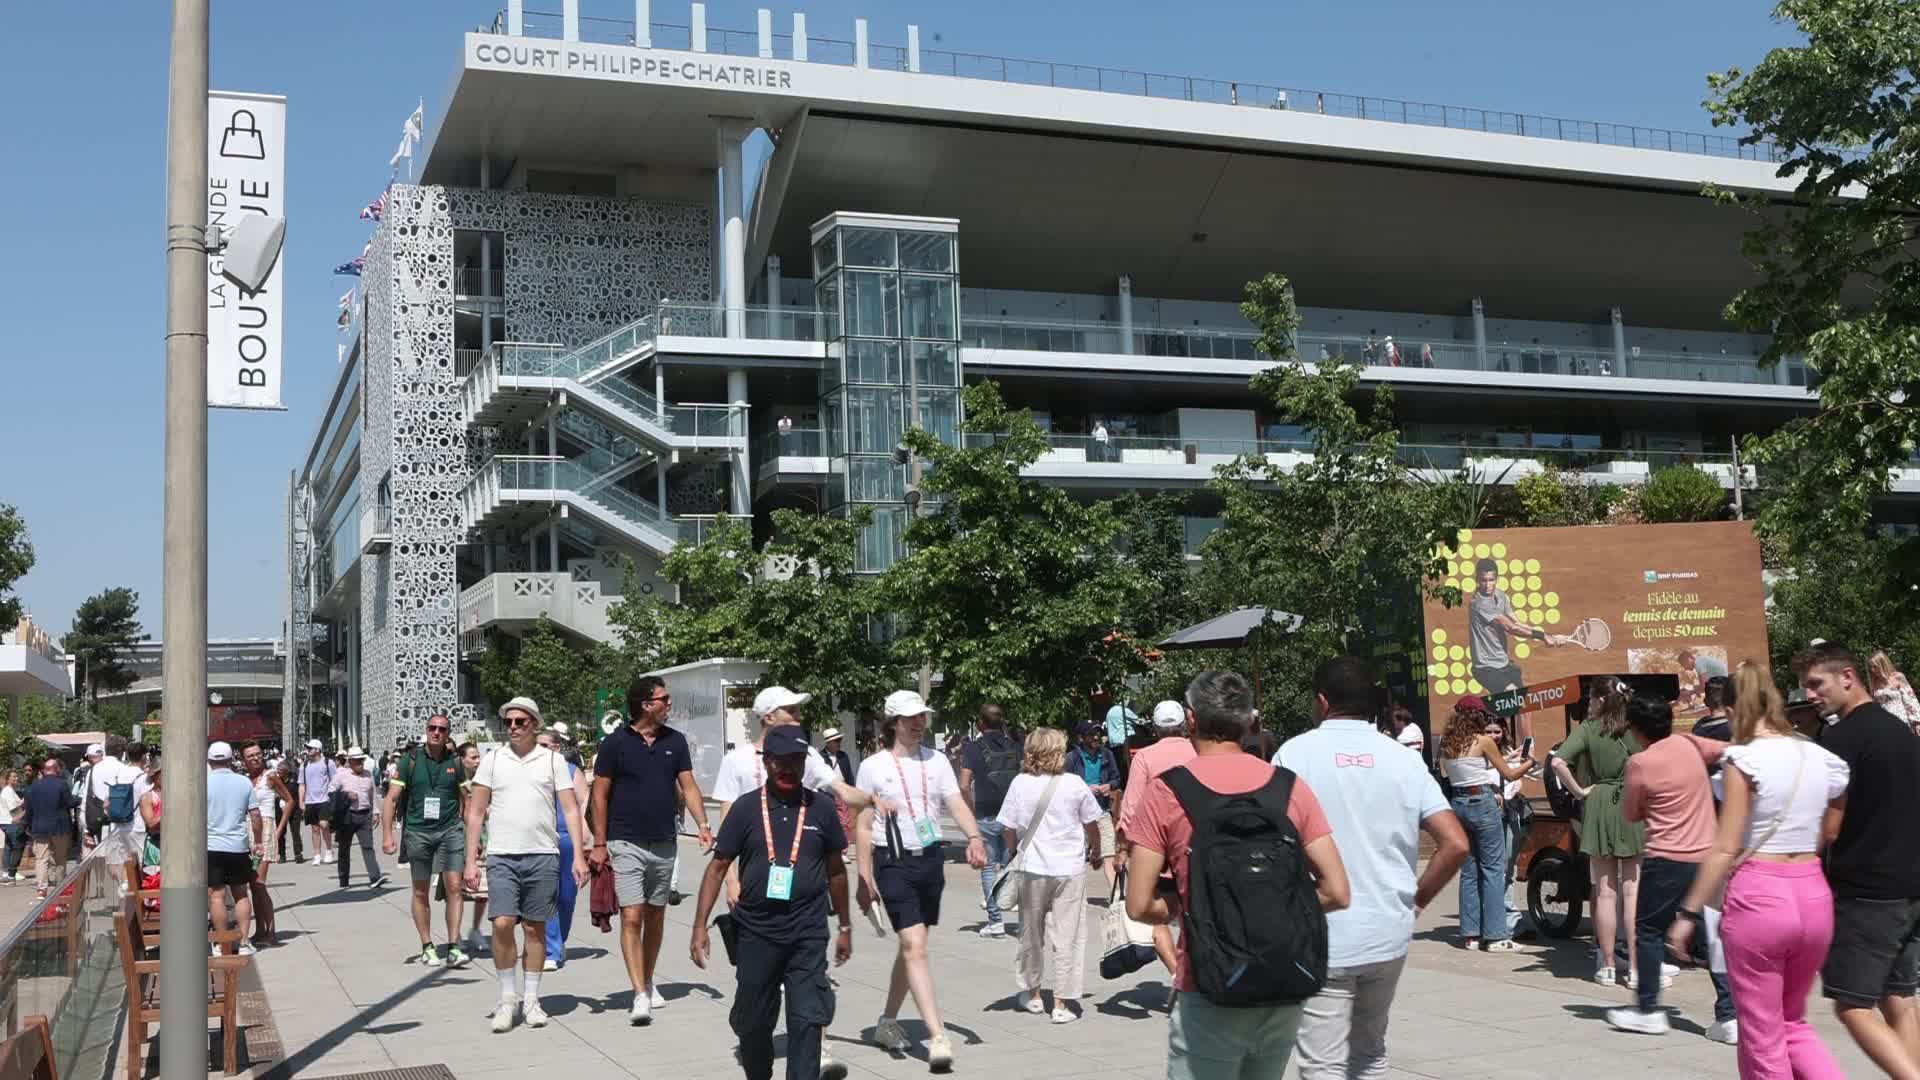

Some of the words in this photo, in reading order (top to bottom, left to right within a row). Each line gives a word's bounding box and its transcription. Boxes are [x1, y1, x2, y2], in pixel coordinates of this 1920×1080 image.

[476, 44, 559, 69] COURT
[567, 51, 791, 88] PHILIPPE-CHATRIER
[210, 177, 227, 276] GNDE
[209, 284, 225, 309] LA
[1647, 592, 1683, 605] Fidèle
[1684, 593, 1699, 603] au
[1624, 609, 1661, 622] tennis
[1662, 608, 1678, 620] de
[1679, 606, 1726, 620] demain
[1633, 625, 1672, 641] depuis
[1673, 625, 1691, 637] 50
[1692, 624, 1718, 636] ans.
[1495, 691, 1525, 711] STAND
[1527, 688, 1563, 710] TATTOO
